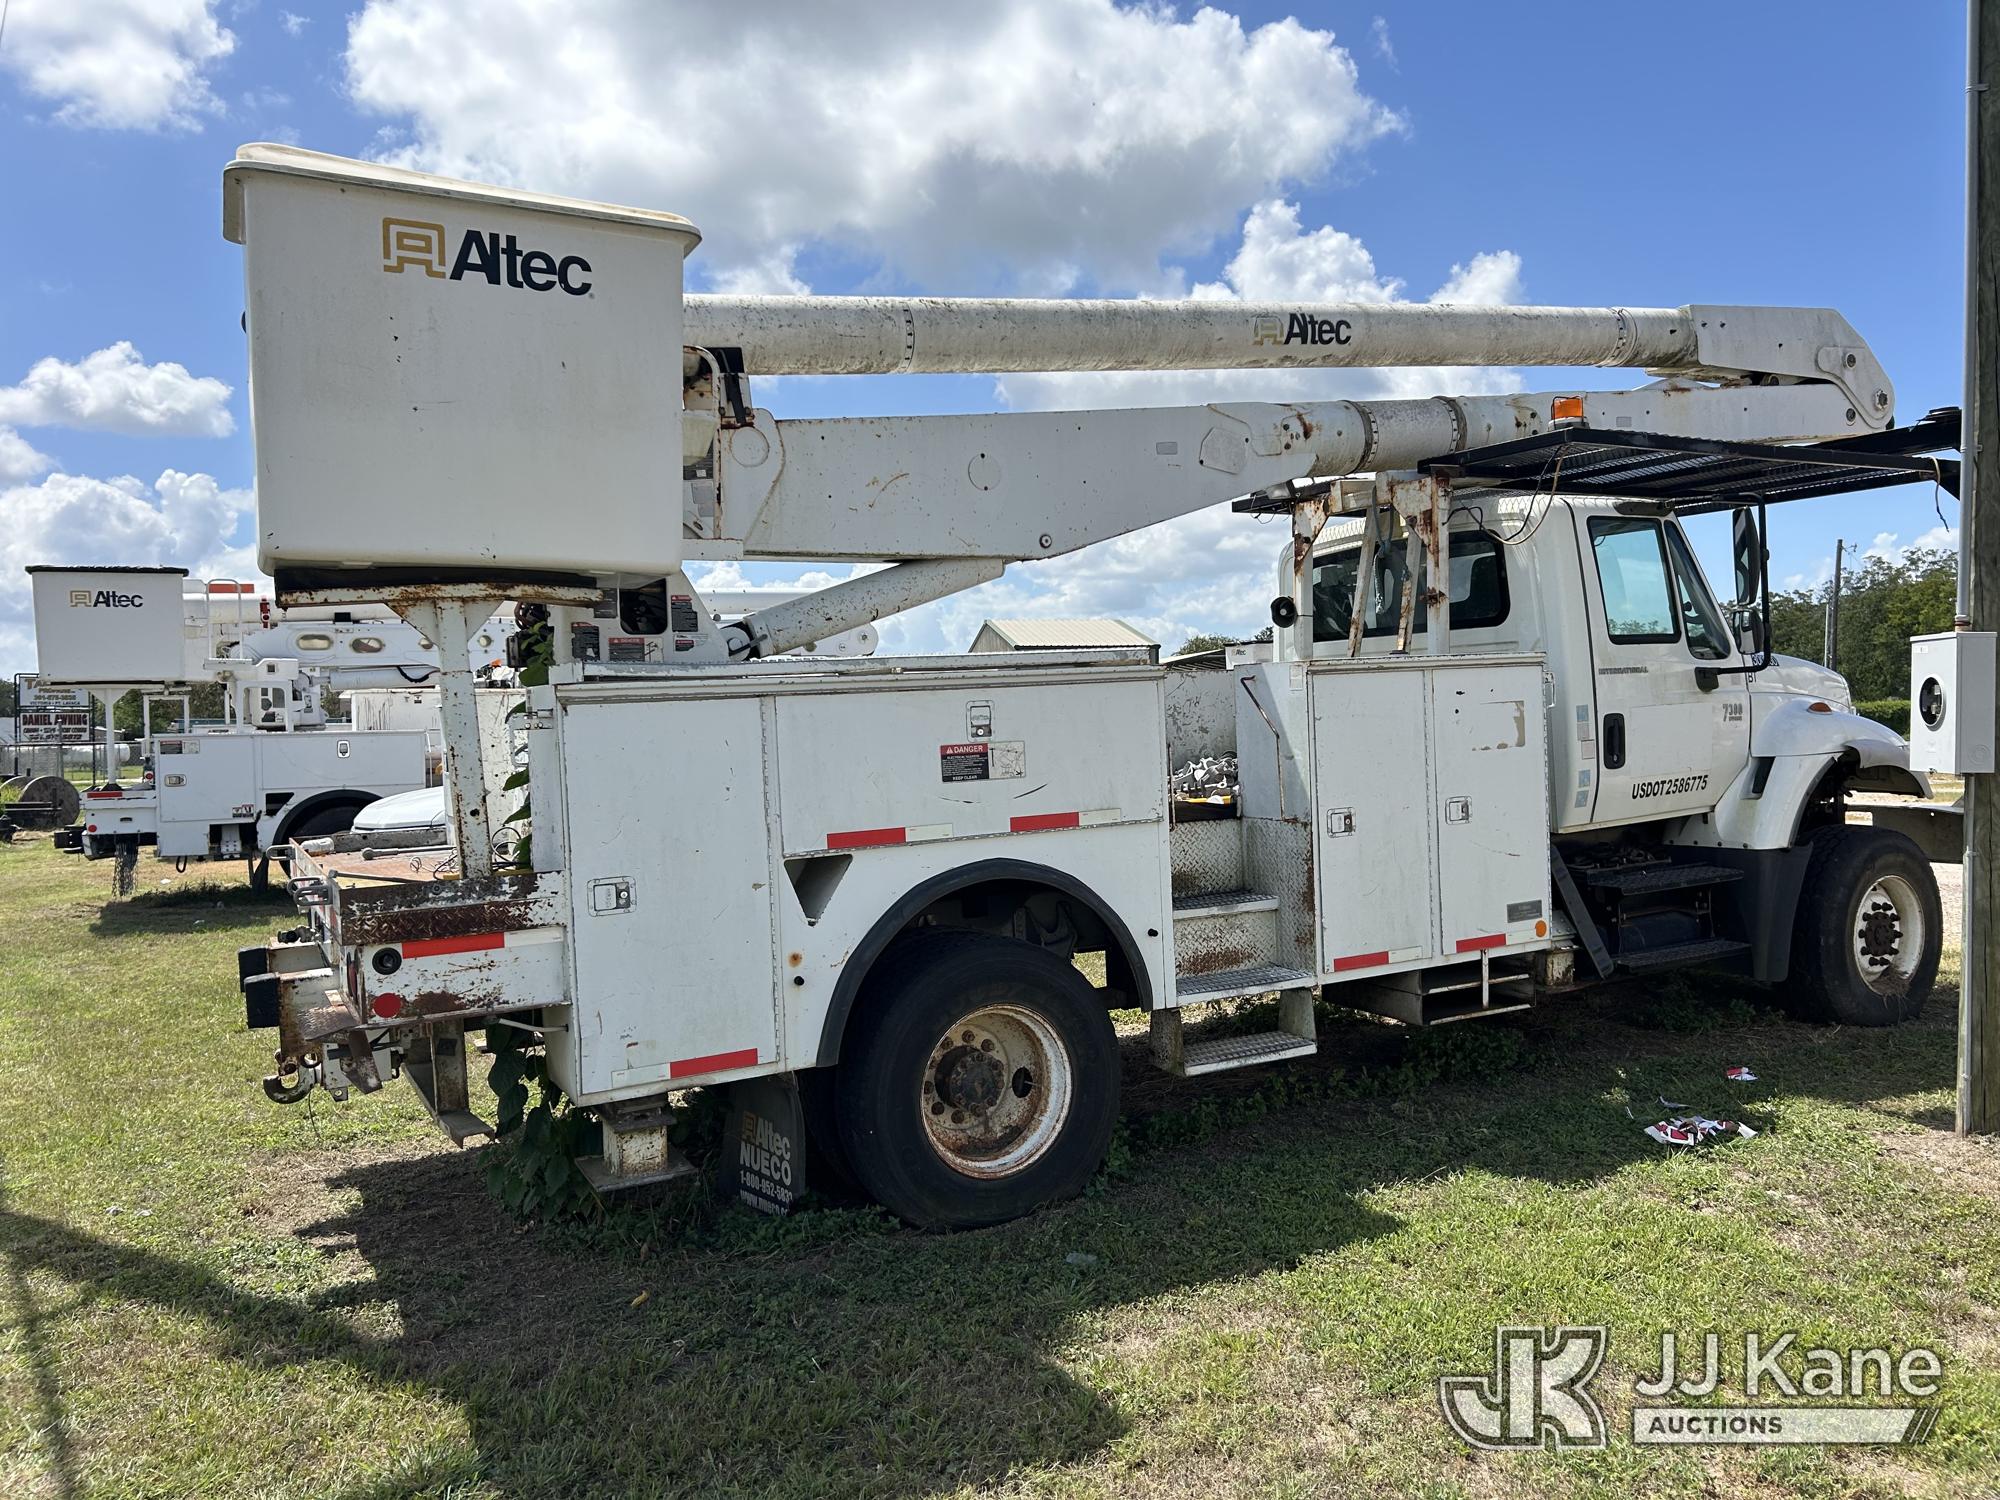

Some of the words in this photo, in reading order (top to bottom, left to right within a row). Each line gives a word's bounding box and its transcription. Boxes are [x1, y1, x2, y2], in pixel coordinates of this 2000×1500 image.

[449, 229, 593, 296] Altec
[1283, 312, 1352, 345] Altec
[93, 590, 144, 608] Altec
[22, 714, 52, 725] DANIEL
[54, 714, 87, 725] AWNING
[954, 745, 983, 753] DANGER
[1631, 775, 1709, 800] USDOT2586775
[755, 1117, 791, 1161] Altec
[740, 1141, 792, 1186] NUECO
